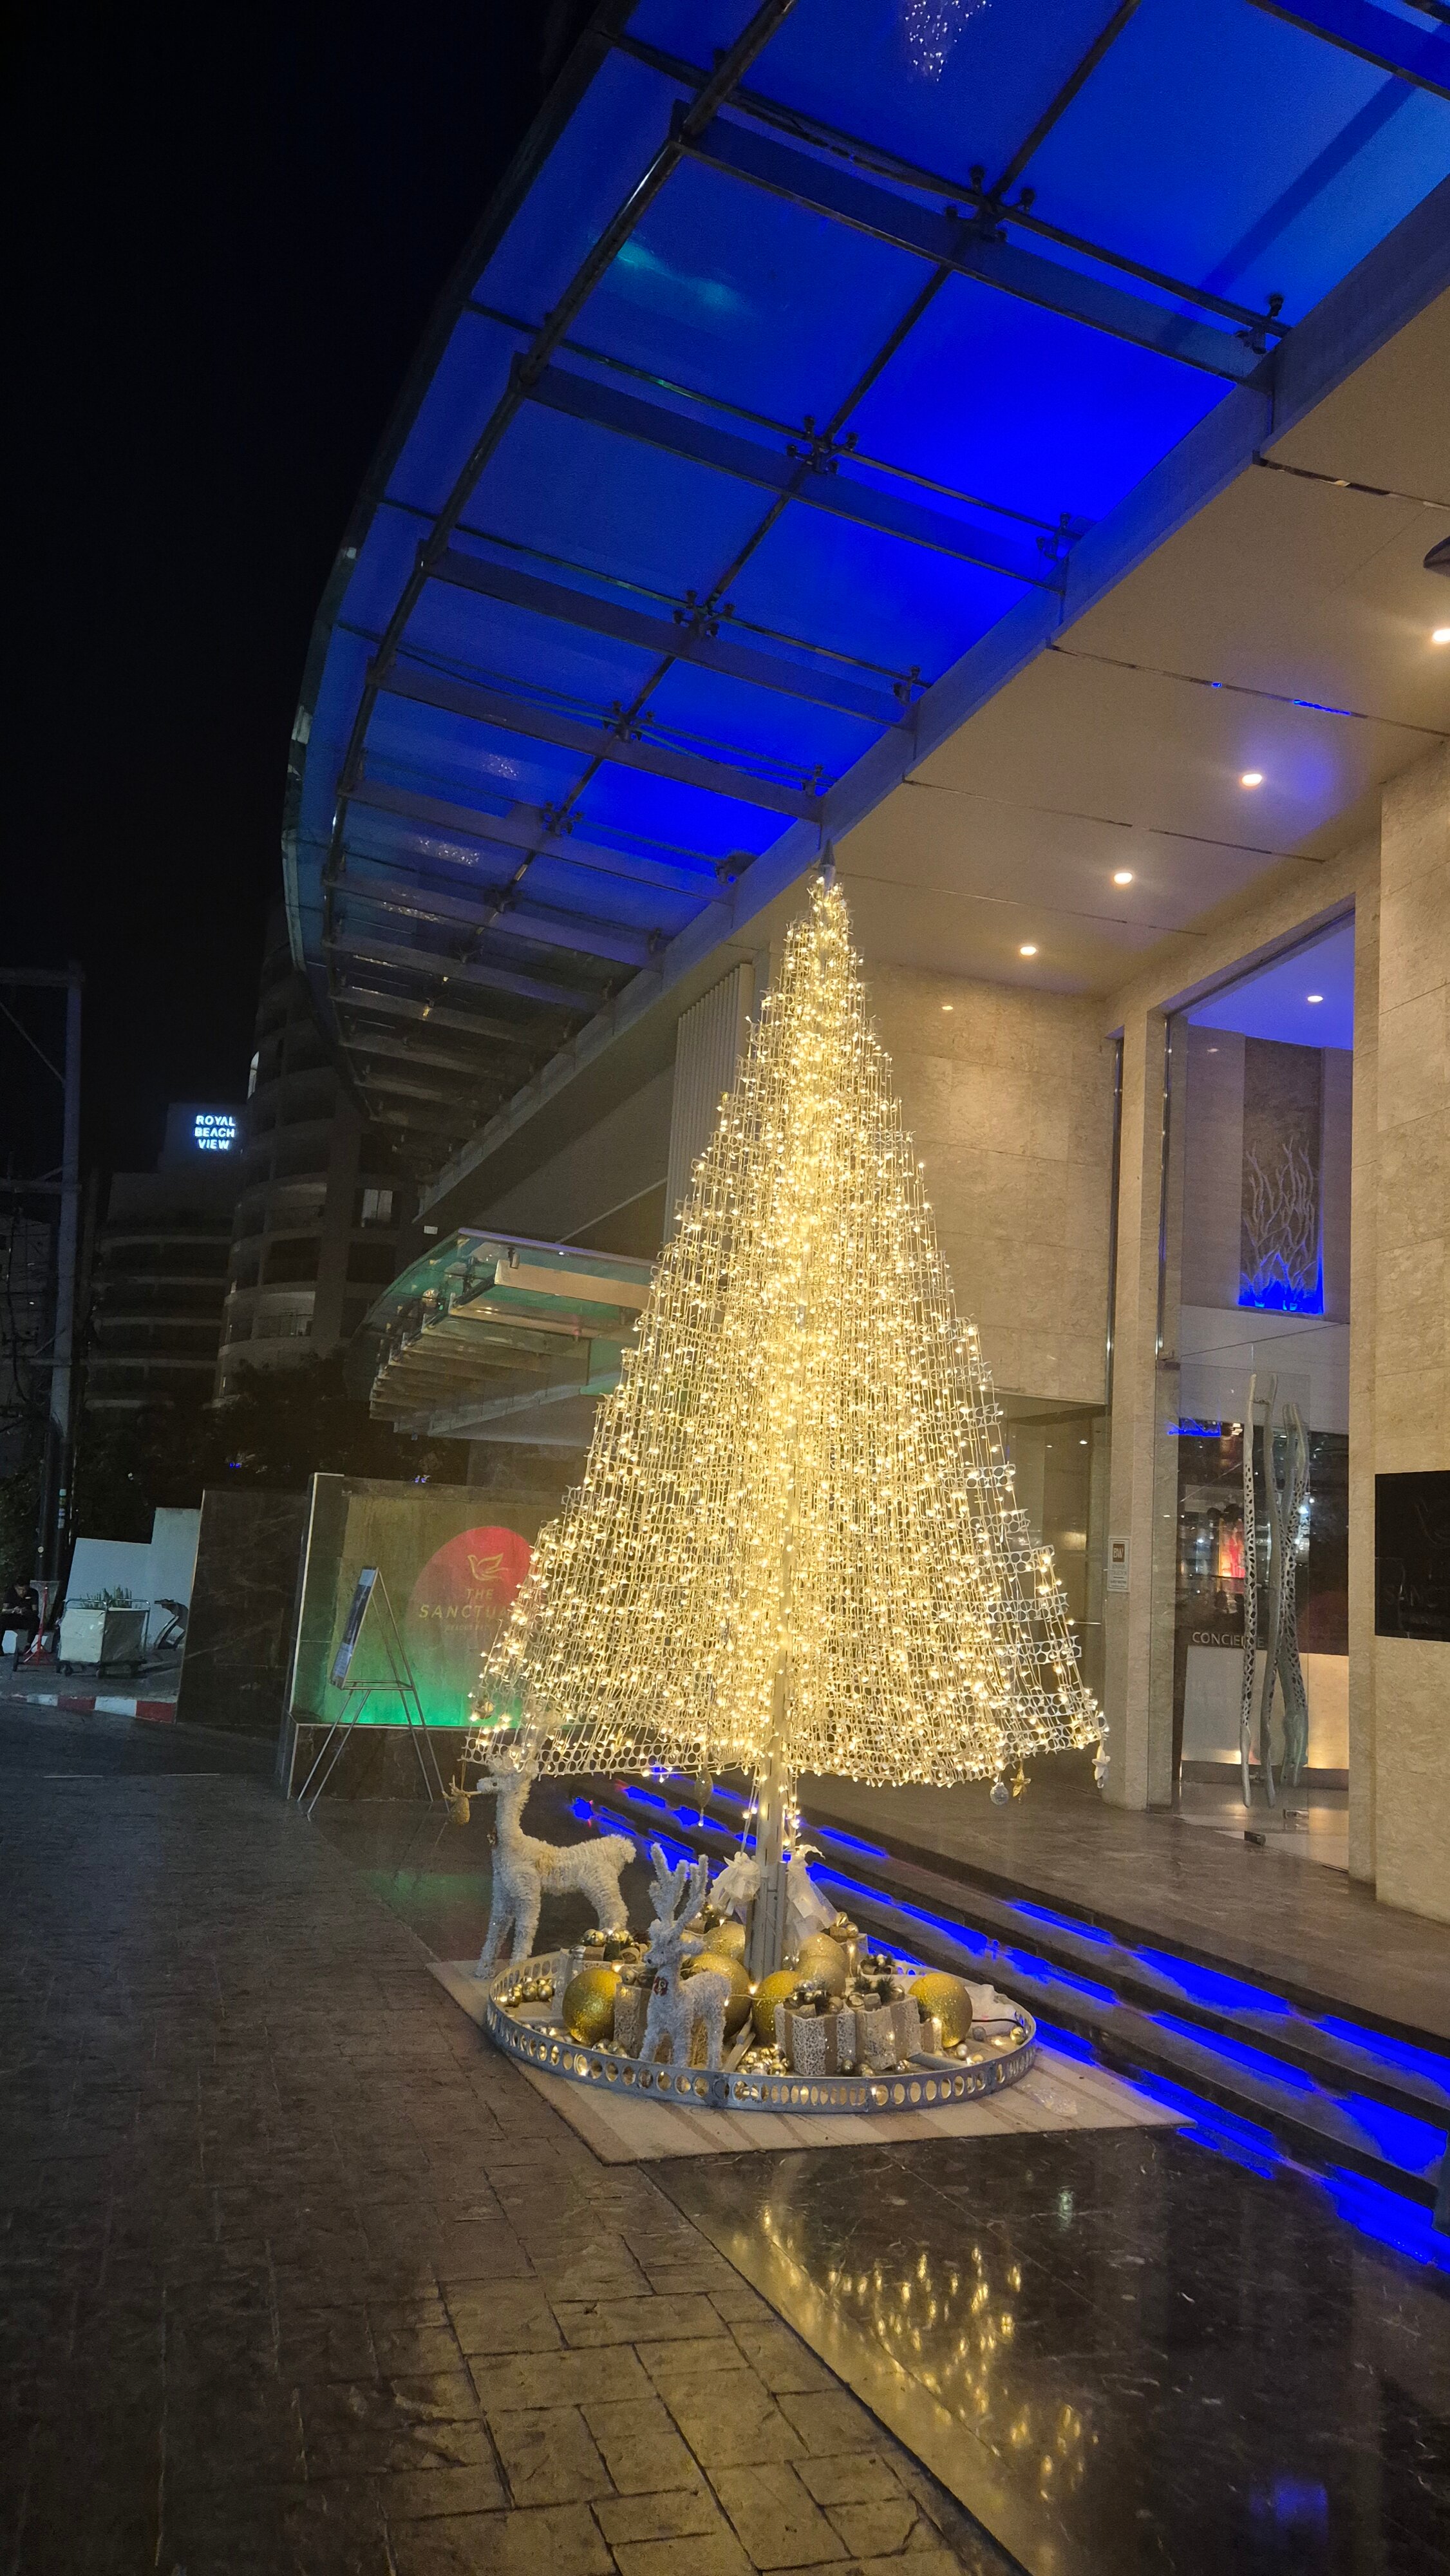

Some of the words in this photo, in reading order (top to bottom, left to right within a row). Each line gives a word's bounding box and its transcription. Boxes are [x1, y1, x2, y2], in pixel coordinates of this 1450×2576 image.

[196, 1115, 236, 1126] ROYAL
[194, 1127, 235, 1138] BEACH
[198, 1139, 230, 1150] VIEW
[466, 1588, 494, 1598] THE
[419, 1604, 510, 1619] SANCTUA
[1192, 1631, 1265, 1648] CONCIEE
